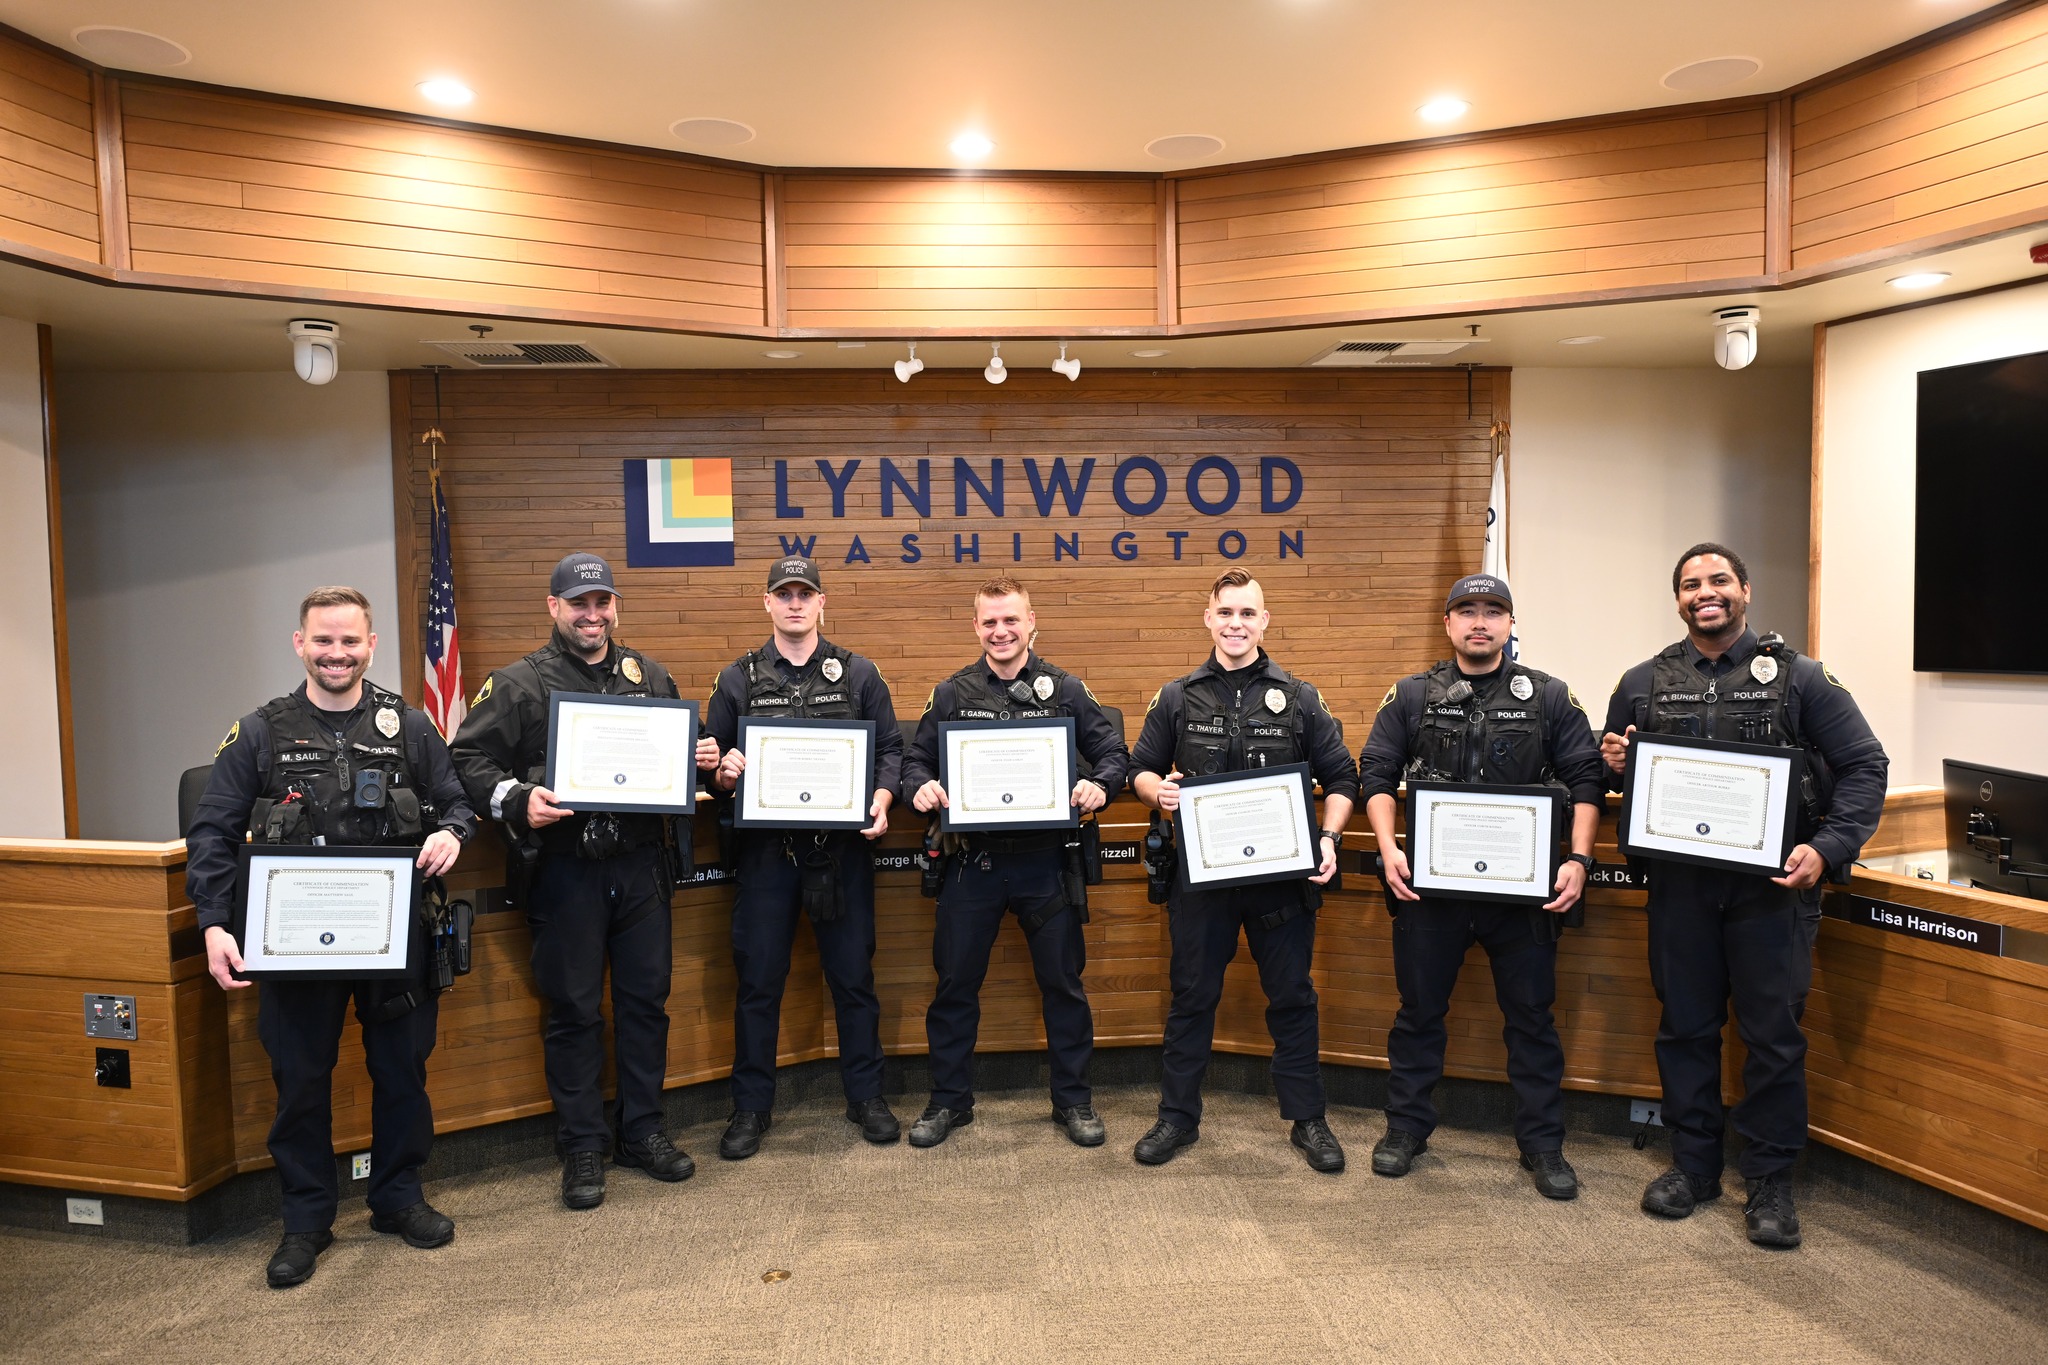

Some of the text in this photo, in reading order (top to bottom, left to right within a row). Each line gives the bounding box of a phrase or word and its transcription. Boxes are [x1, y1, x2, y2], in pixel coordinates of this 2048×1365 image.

[775, 456, 1303, 518] LYNNWOOD
[778, 530, 1304, 564] WASHINGTON
[573, 563, 604, 573] LYNNWOOD
[781, 560, 808, 569] LYNNWOOD
[580, 571, 602, 580] POLICE
[785, 567, 804, 575] POLICE
[1464, 579, 1495, 589] LYNNWOOD
[815, 694, 842, 703] POLICE
[1671, 693, 1700, 701] BURKE
[1733, 691, 1768, 699] POLICE
[967, 710, 995, 719] GASKIN
[1022, 709, 1050, 718] POLICE
[1497, 711, 1527, 719] POLICE
[1187, 723, 1224, 734] C. THAYER
[1254, 728, 1283, 736] POLICE
[370, 746, 398, 755] OLICE
[281, 752, 321, 762] M. SAUL
[1100, 846, 1135, 858] rizzell
[874, 856, 910, 868] eorge
[1871, 906, 1978, 944] Lisa Harrison
